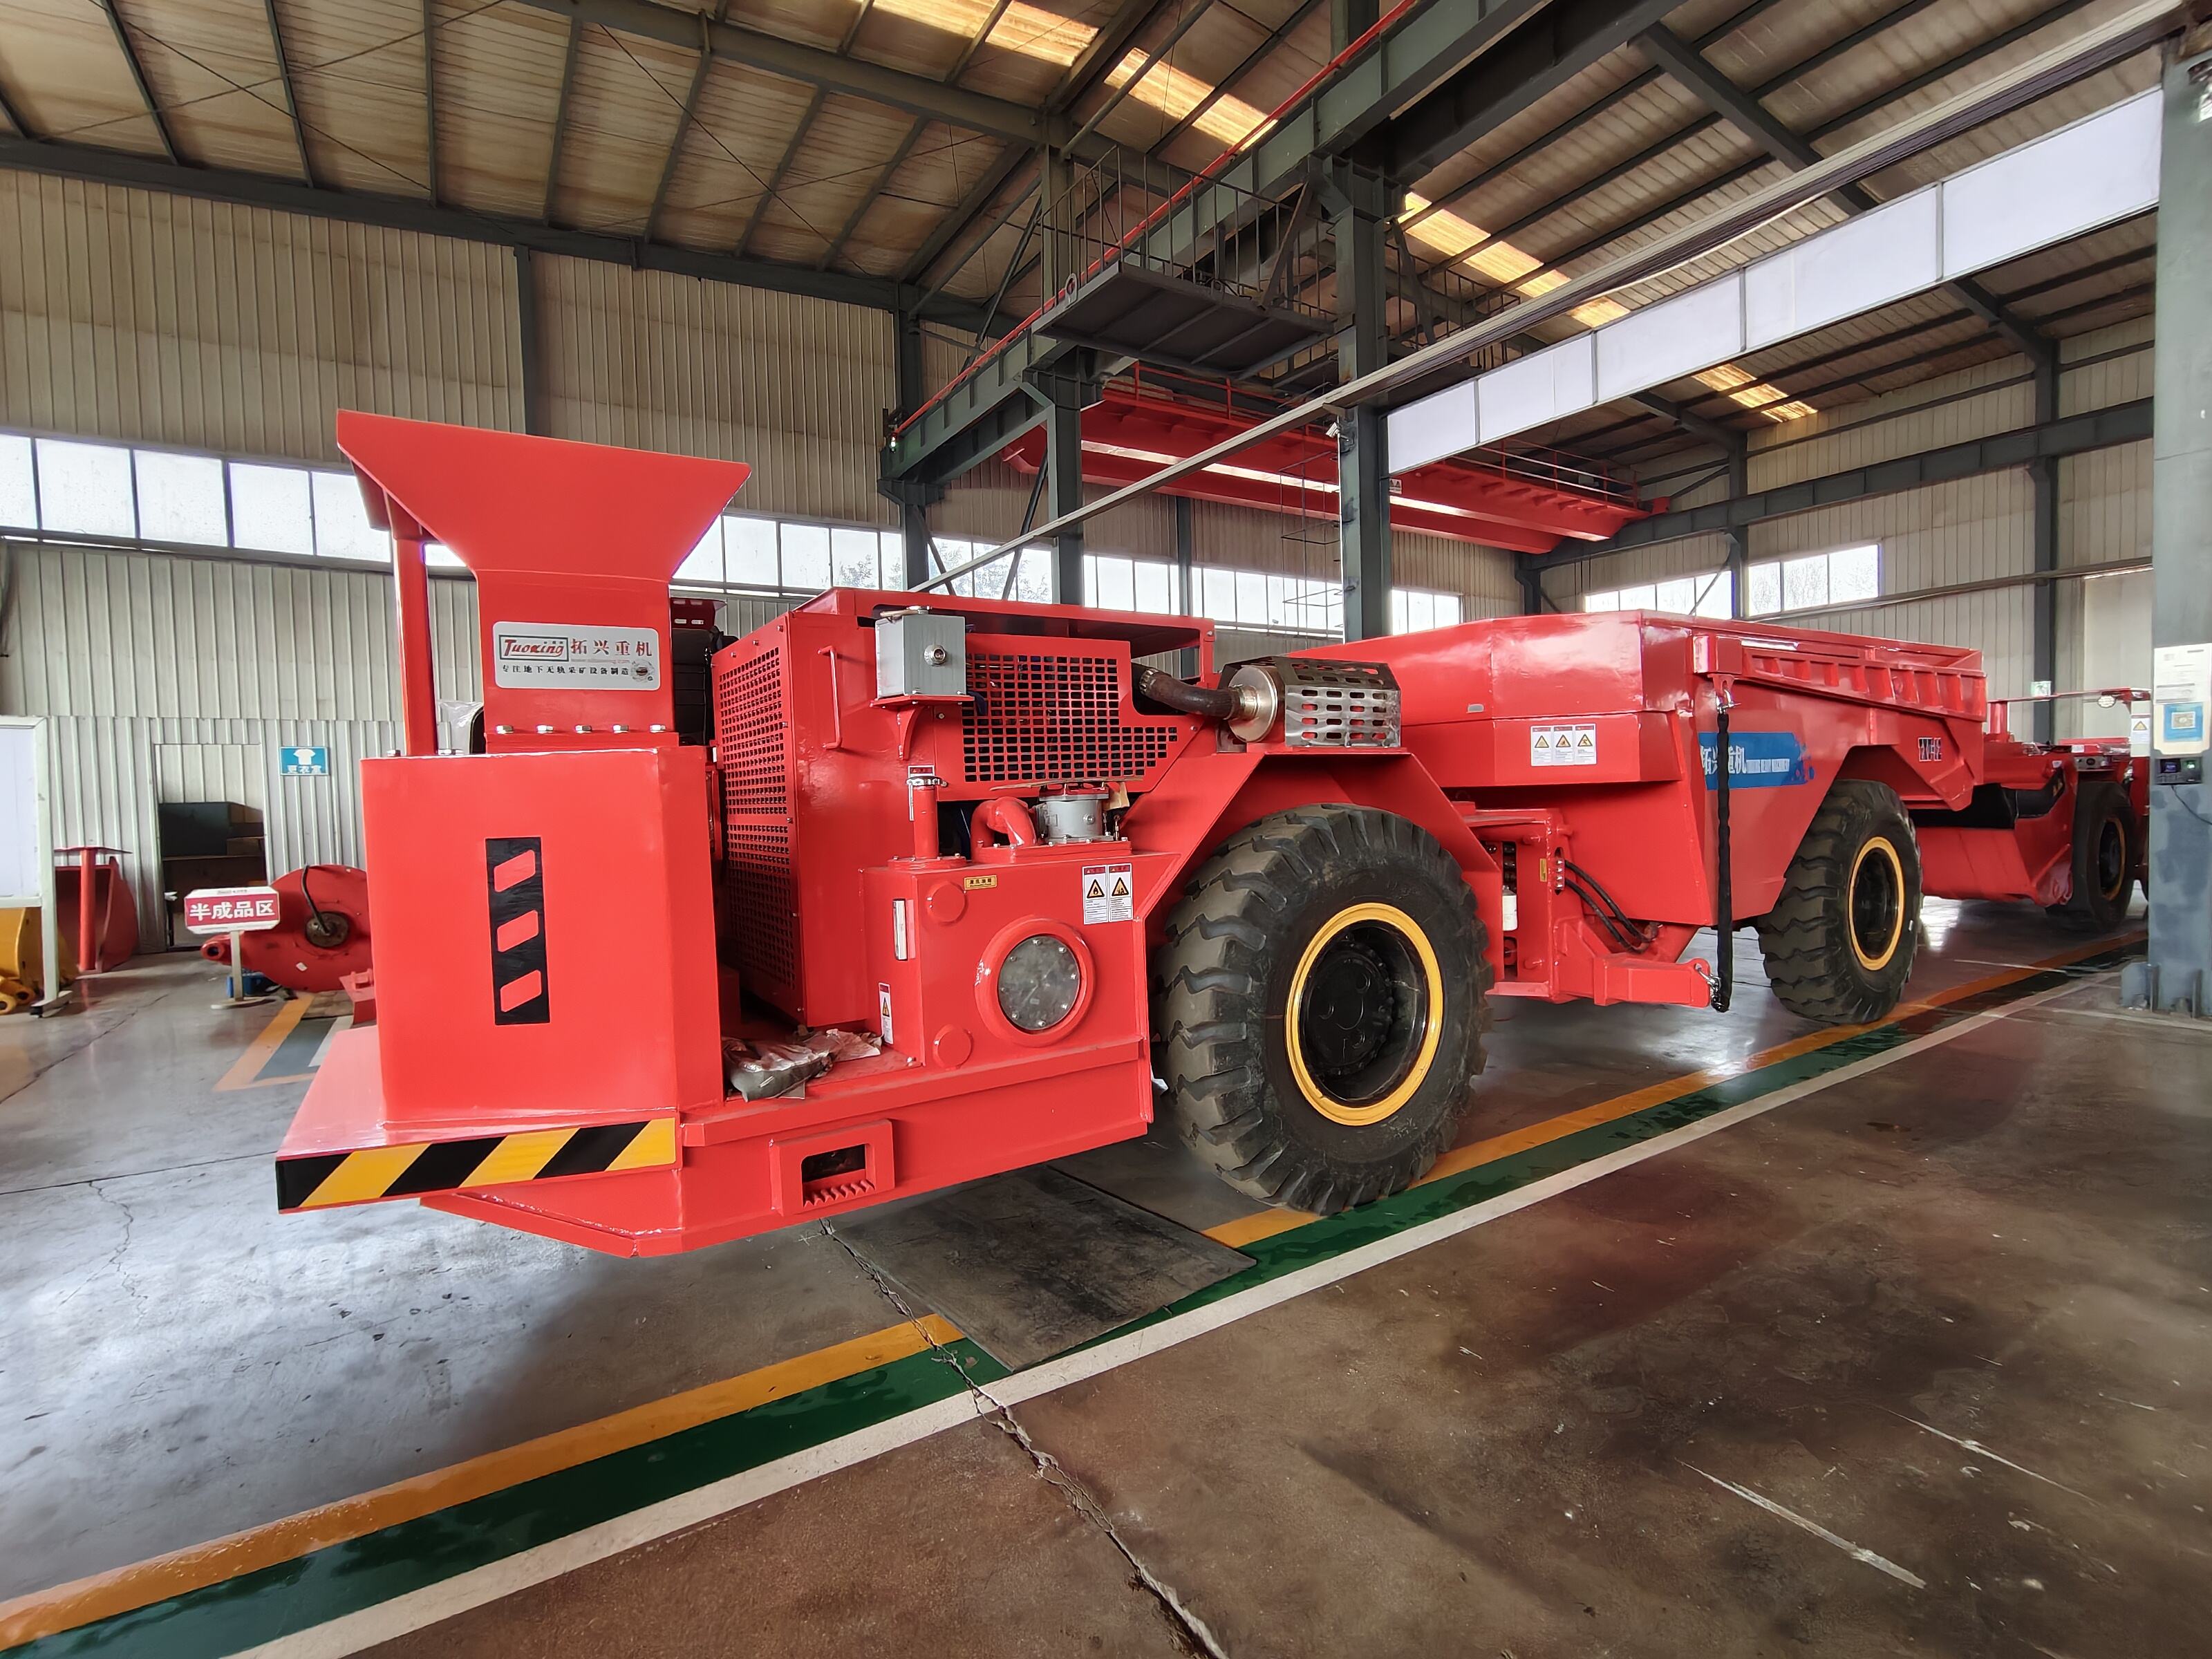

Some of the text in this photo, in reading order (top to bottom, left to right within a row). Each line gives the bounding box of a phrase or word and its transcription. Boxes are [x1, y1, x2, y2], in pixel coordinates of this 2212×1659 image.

[570, 638, 653, 657] 拓兴重机
[189, 900, 275, 921] 半成品区
